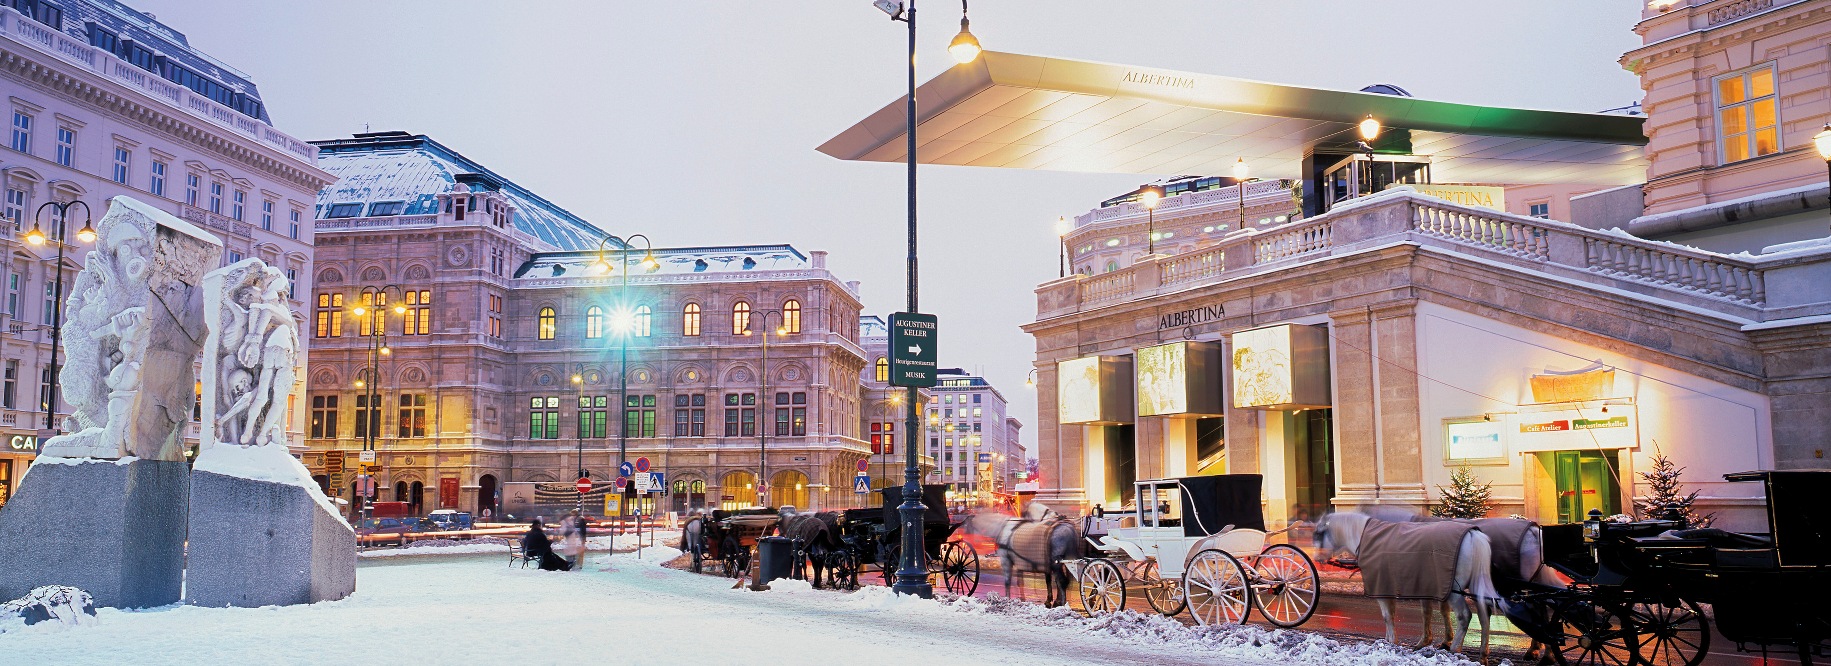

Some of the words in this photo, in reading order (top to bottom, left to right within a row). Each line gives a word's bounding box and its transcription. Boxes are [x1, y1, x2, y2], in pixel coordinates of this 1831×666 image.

[1122, 71, 1194, 89] ALBERTINA
[1160, 303, 1225, 329] ALBERTINA
[895, 320, 935, 330] AUGUSTINER
[903, 329, 927, 337] KELLER
[905, 371, 926, 379] MUSIK
